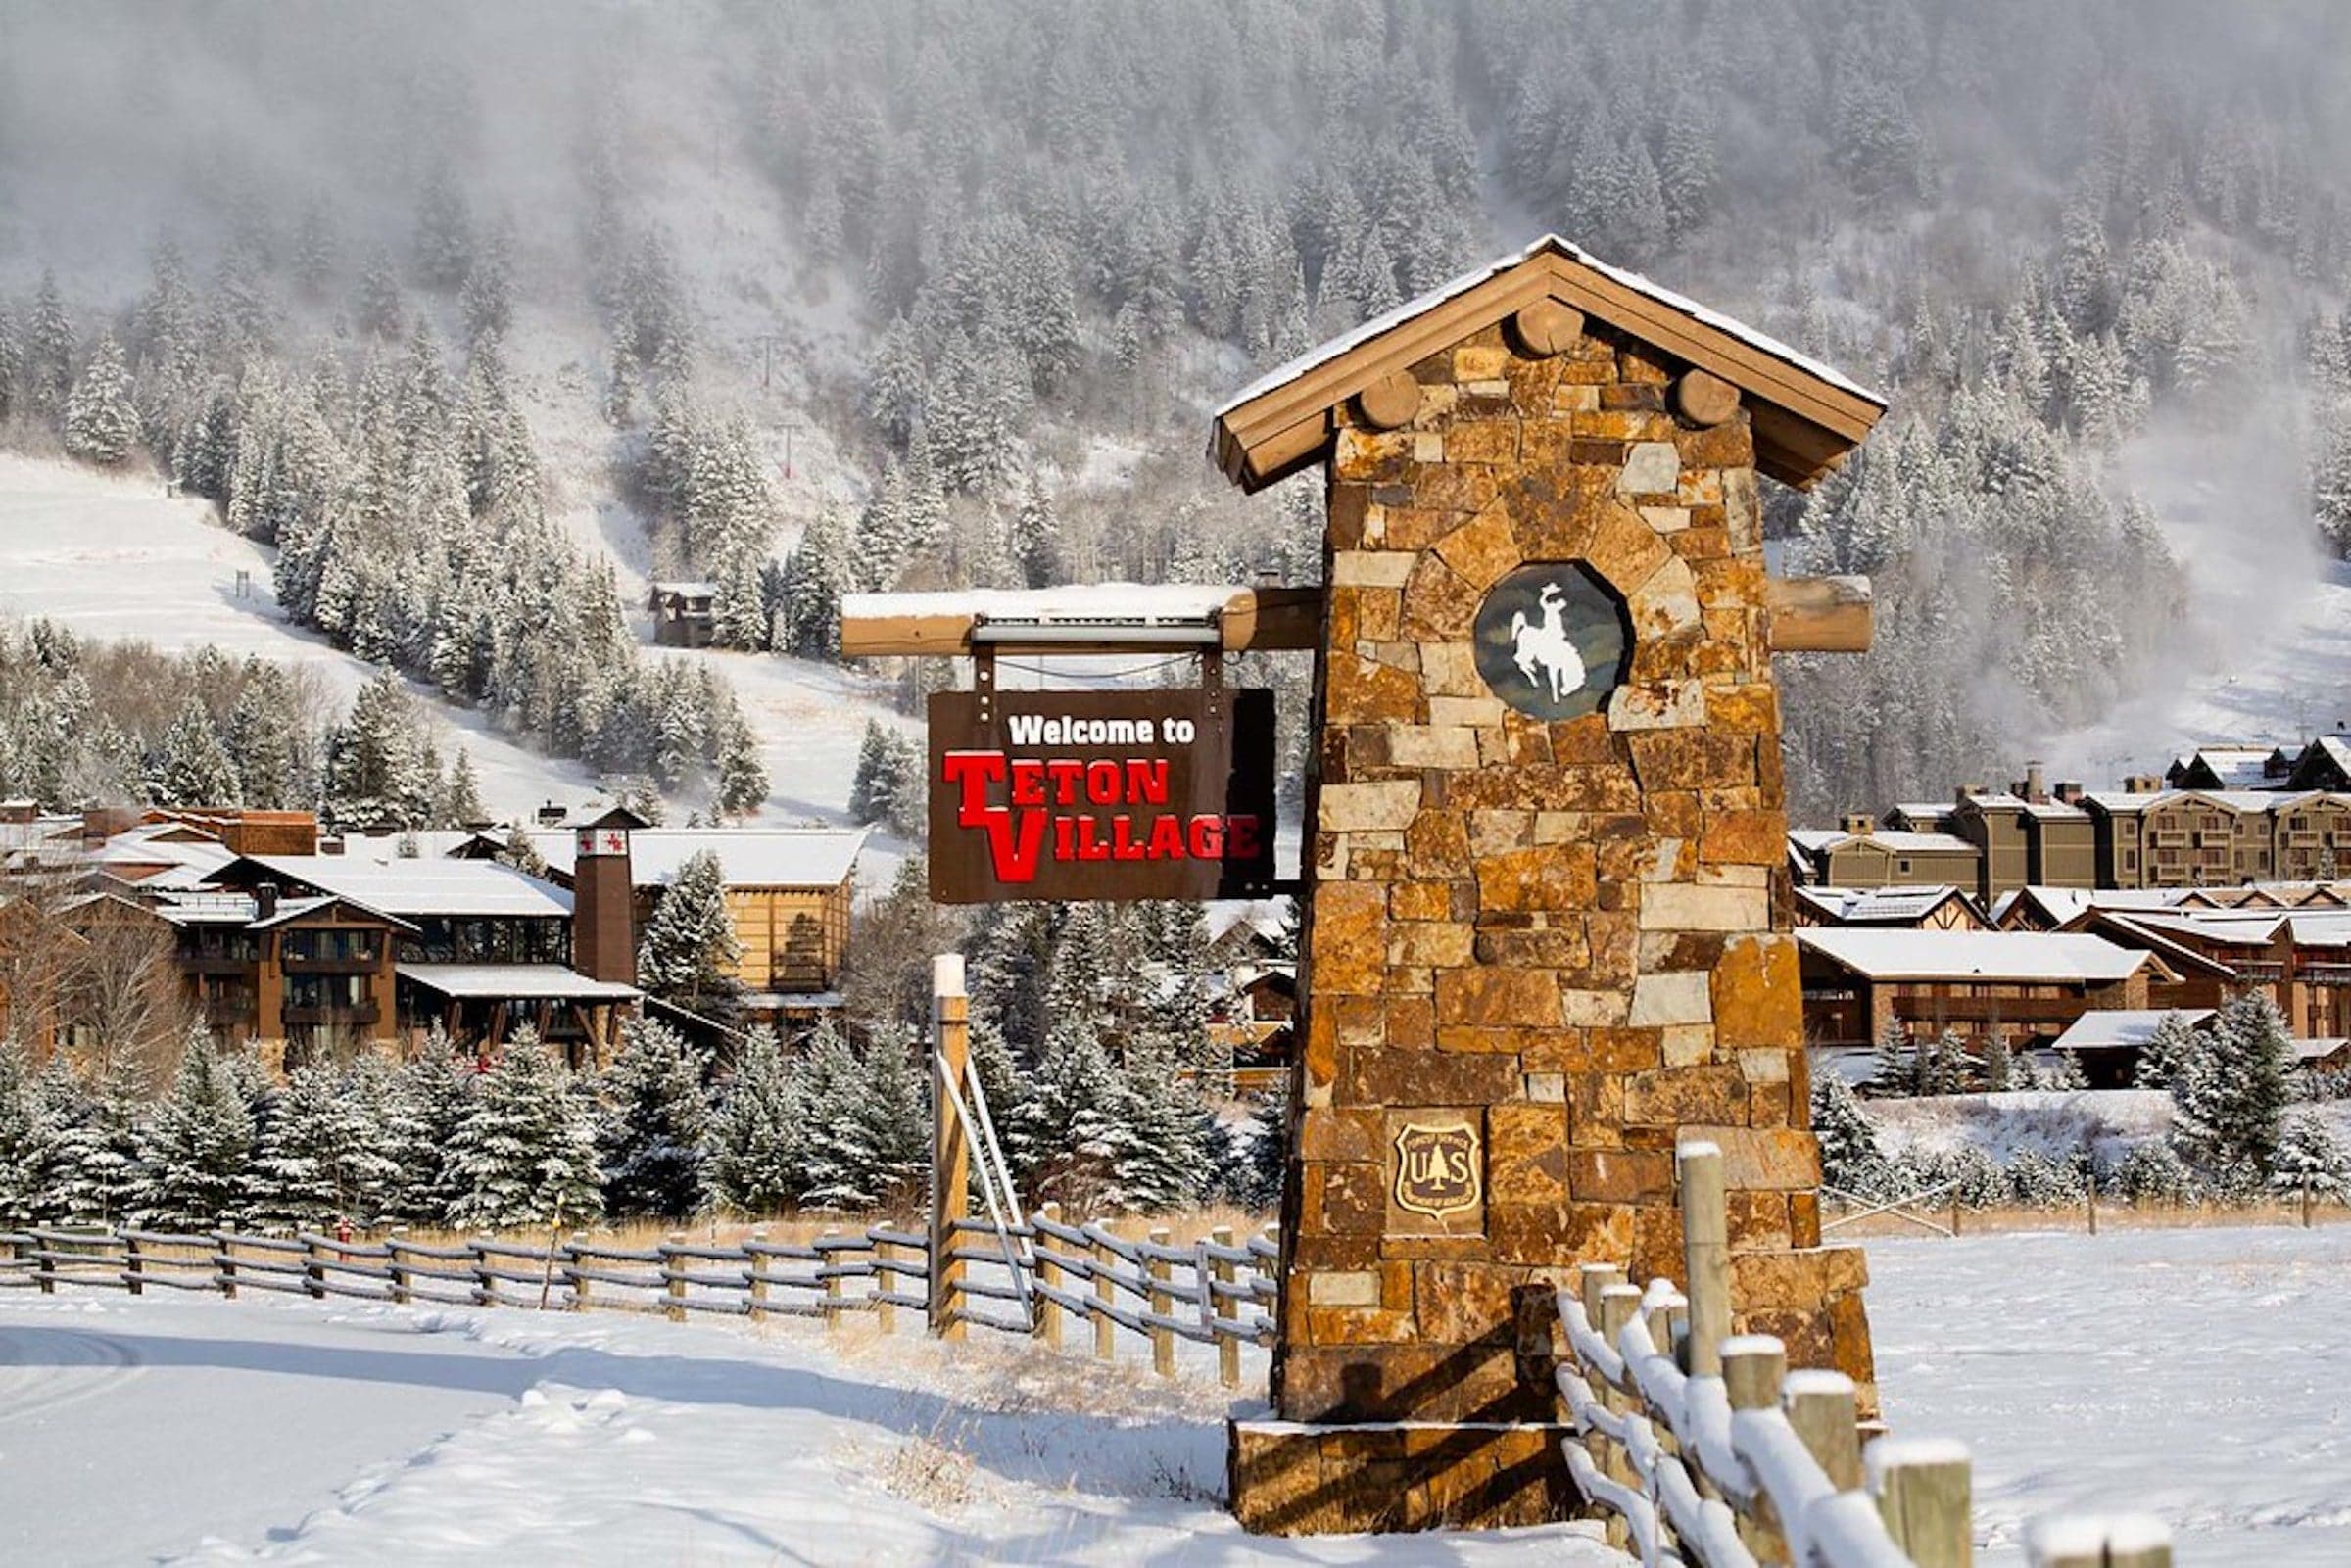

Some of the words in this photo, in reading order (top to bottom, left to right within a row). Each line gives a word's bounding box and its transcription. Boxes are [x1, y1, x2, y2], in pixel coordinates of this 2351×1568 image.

[1009, 715, 1154, 744] Welcome
[1163, 718, 1196, 743] to
[943, 750, 1169, 827] TETON
[984, 806, 1261, 883] VILLAGE
